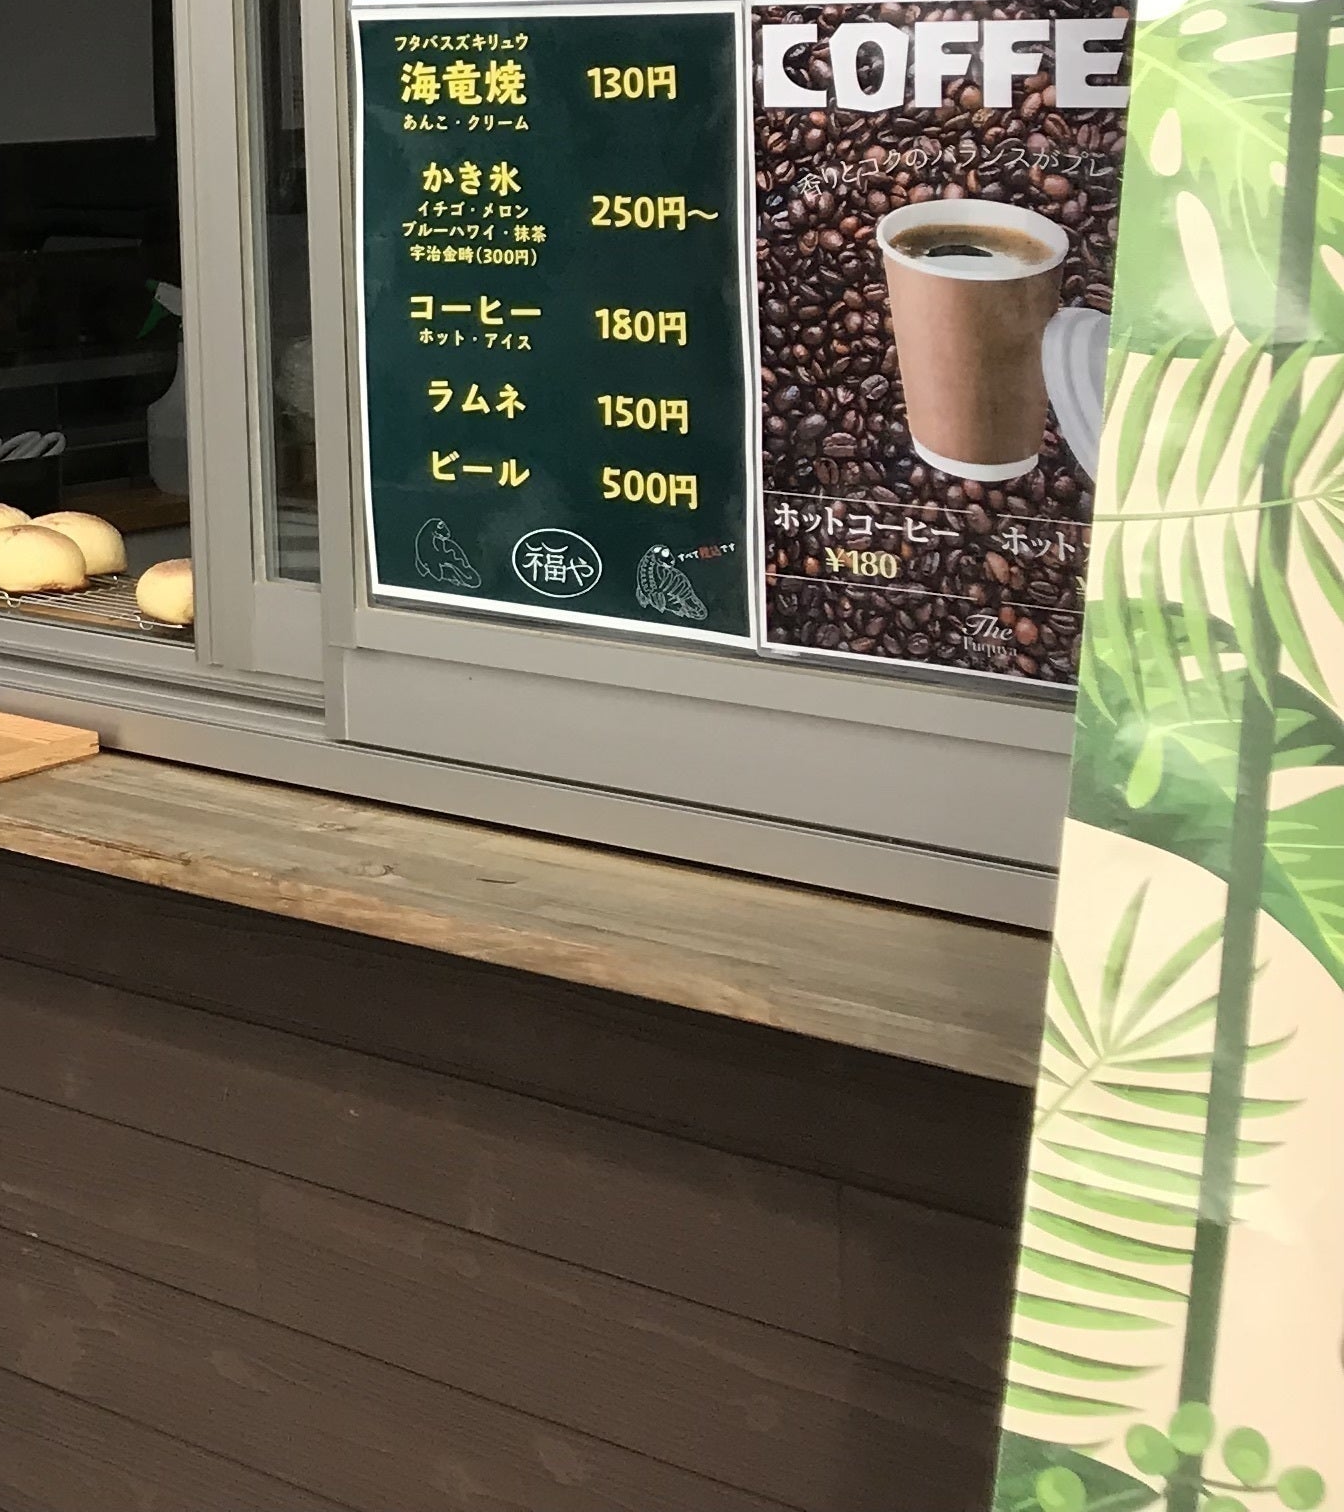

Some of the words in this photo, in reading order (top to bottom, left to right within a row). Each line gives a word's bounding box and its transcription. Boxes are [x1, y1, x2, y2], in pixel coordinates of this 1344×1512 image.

[394, 32, 529, 52] フタバスズキリュウ
[400, 59, 528, 106] 海竜焼
[586, 64, 677, 100] 130円
[403, 112, 530, 132] あんこ・クリーム
[422, 161, 523, 197] かき氷
[417, 201, 530, 219] イチゴ・メロン
[401, 220, 547, 244] ブルーハワイ・抹茶
[410, 294, 541, 326] コーヒー
[595, 307, 687, 347] 180円
[419, 328, 532, 351] ホット・アイス
[428, 380, 526, 420] ラムネ
[597, 394, 689, 435] 150円
[431, 450, 530, 488] ビール
[602, 467, 698, 511] 500円
[774, 502, 960, 543] ホットコーヒー
[1001, 526, 1084, 562] ホット
[522, 541, 595, 587] 福や
[825, 547, 899, 580] ¥180
[960, 613, 1014, 642] The
